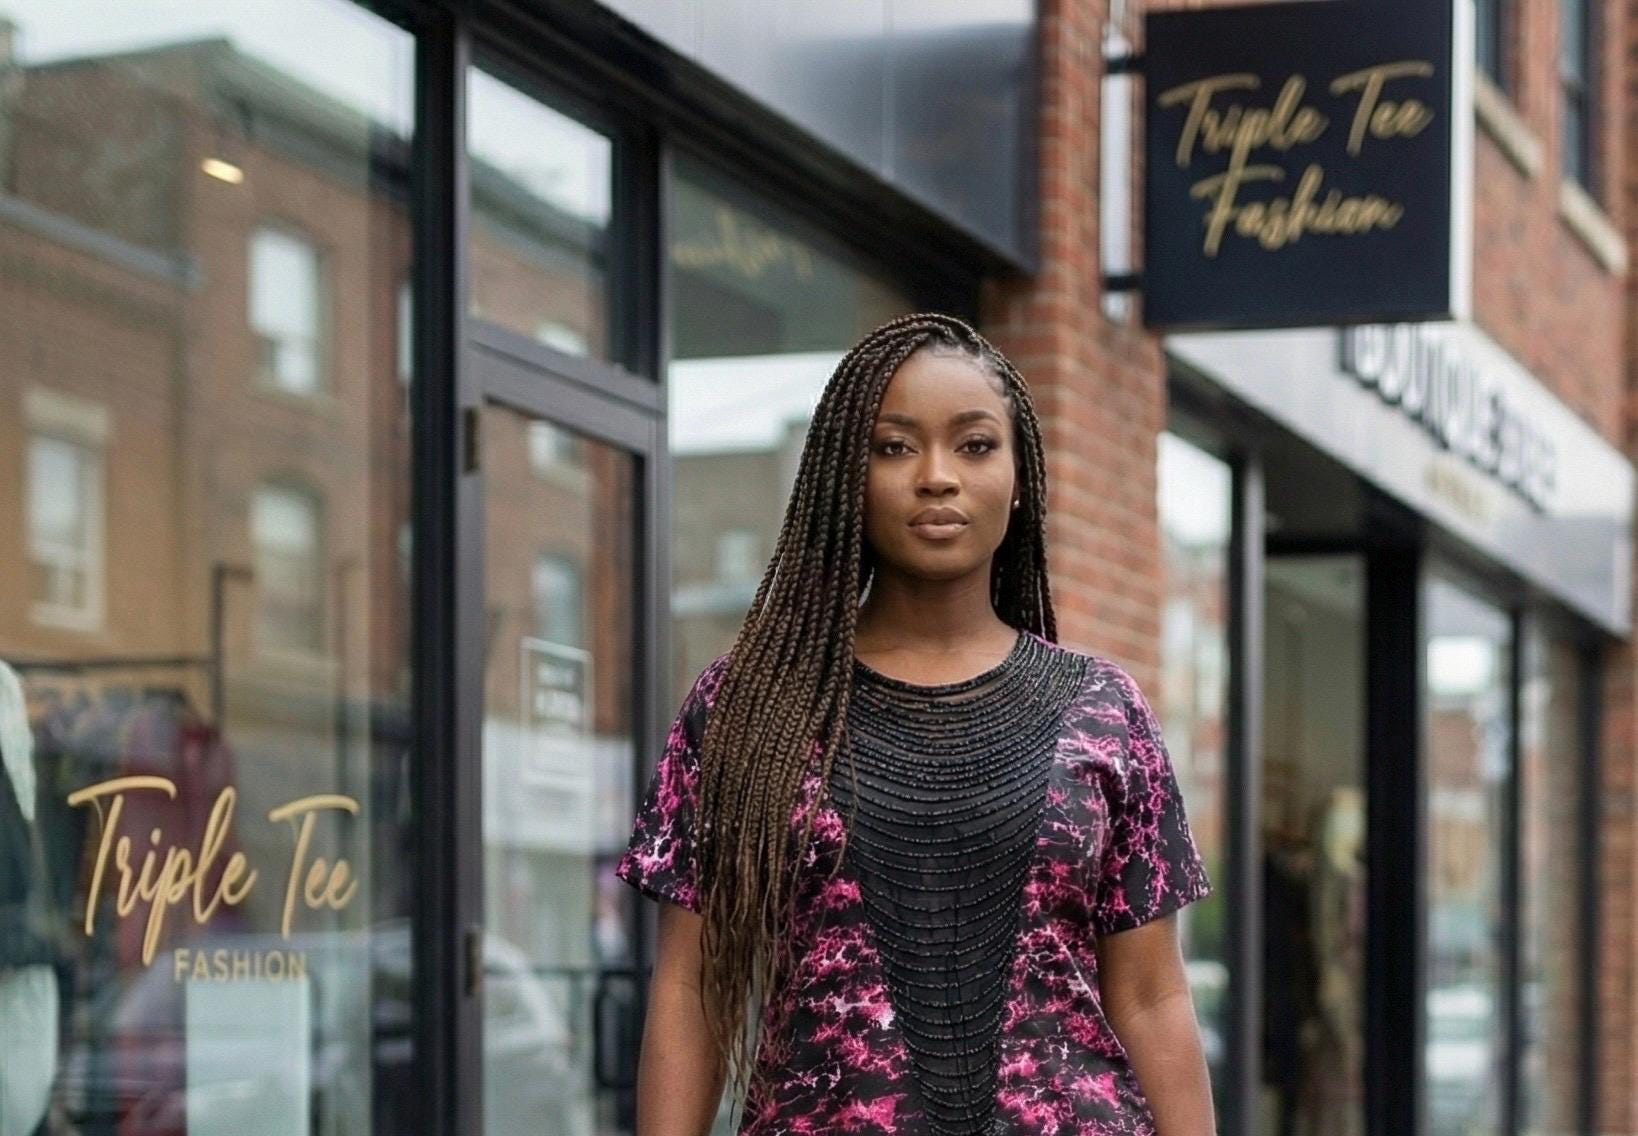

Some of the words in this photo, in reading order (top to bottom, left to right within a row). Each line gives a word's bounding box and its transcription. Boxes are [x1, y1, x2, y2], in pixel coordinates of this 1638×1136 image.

[1157, 73, 1330, 172] Triple
[1329, 60, 1435, 157] Tee
[1189, 163, 1405, 258] Fashion
[68, 775, 258, 966] Triple
[268, 793, 360, 939] Tee
[173, 947, 307, 982] FASHION
